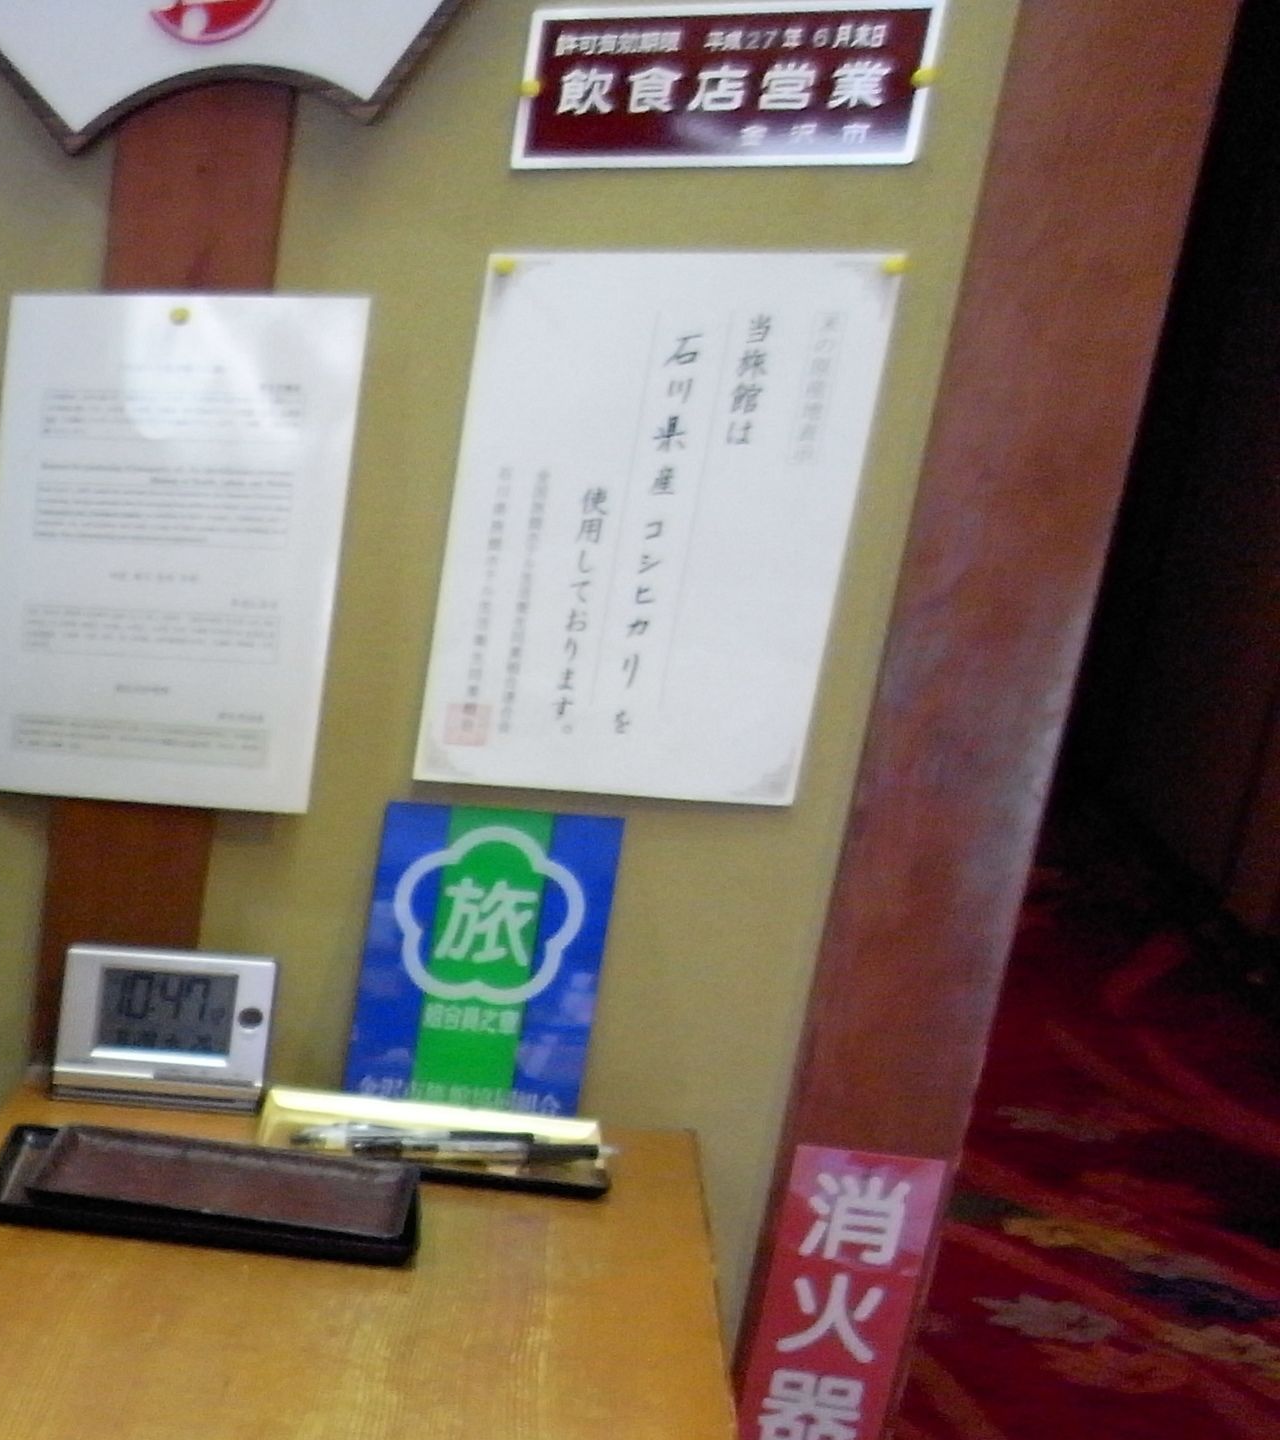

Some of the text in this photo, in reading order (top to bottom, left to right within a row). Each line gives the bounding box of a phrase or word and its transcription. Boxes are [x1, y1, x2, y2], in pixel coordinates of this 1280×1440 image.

[555, 61, 893, 116] 飲食店営業
[726, 312, 773, 446] 当旅館は
[435, 876, 539, 968] 旅
